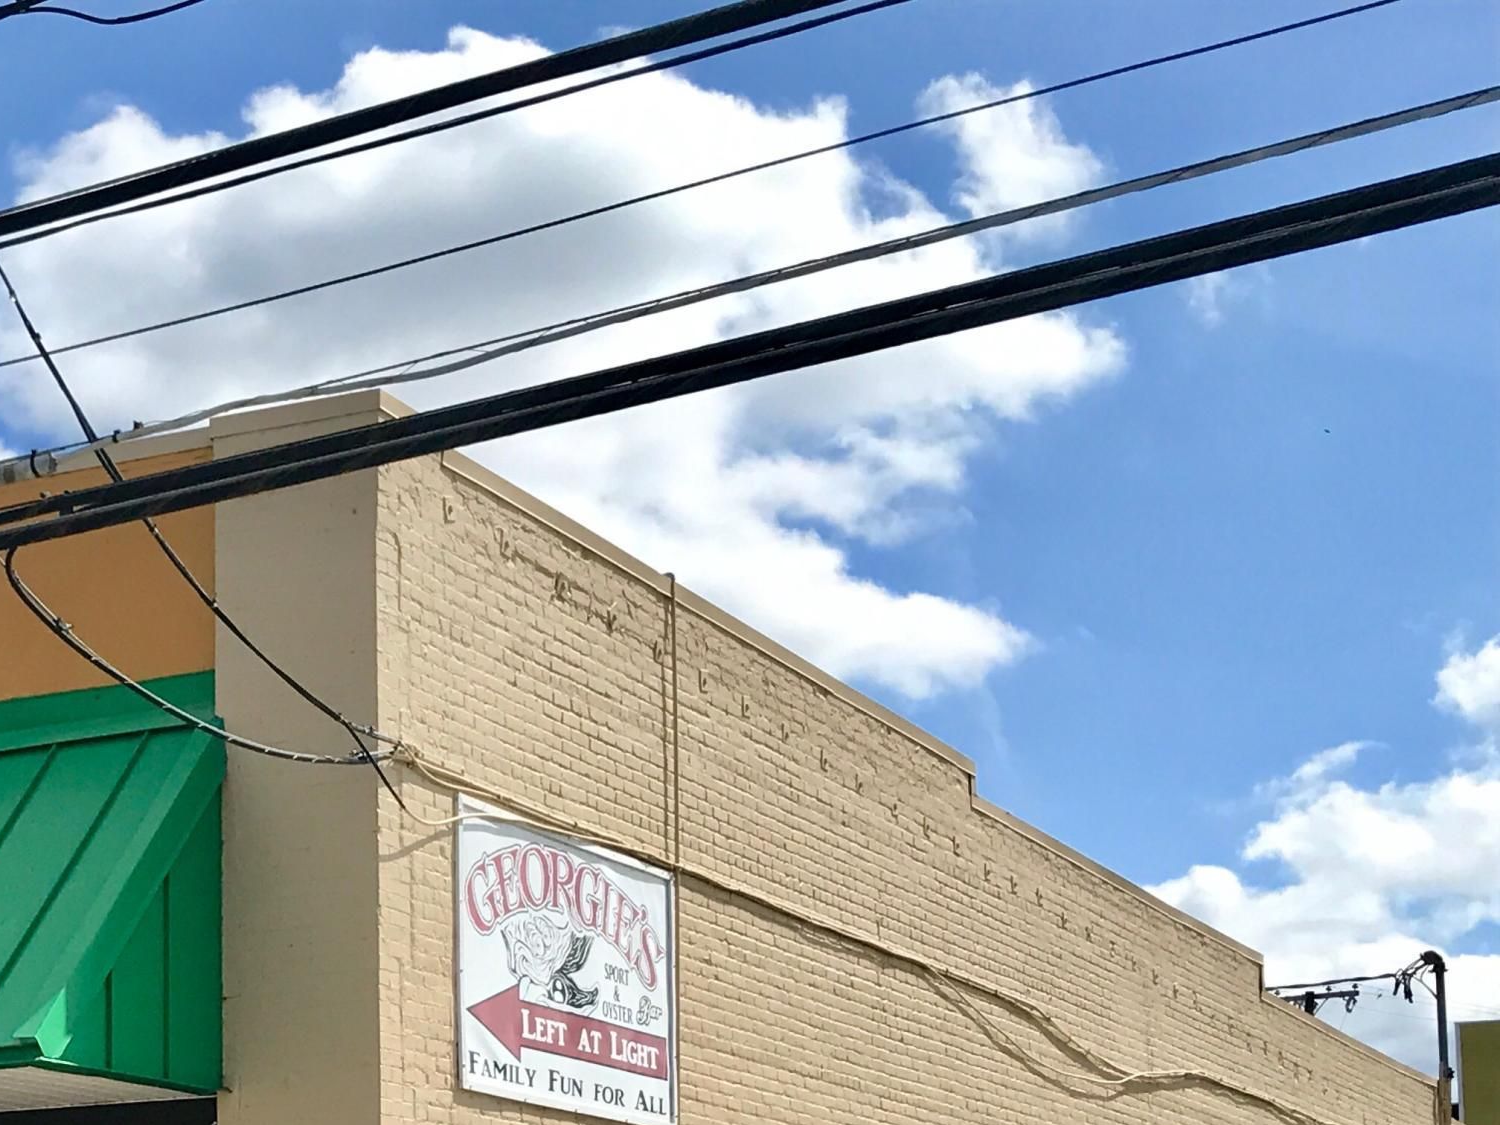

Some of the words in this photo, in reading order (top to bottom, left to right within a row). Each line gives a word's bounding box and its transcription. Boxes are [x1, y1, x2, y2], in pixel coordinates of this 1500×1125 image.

[464, 842, 665, 991] GEORGIE'S
[604, 962, 629, 986] SPORT
[613, 985, 621, 1002] &
[602, 1000, 633, 1025] OYSTER
